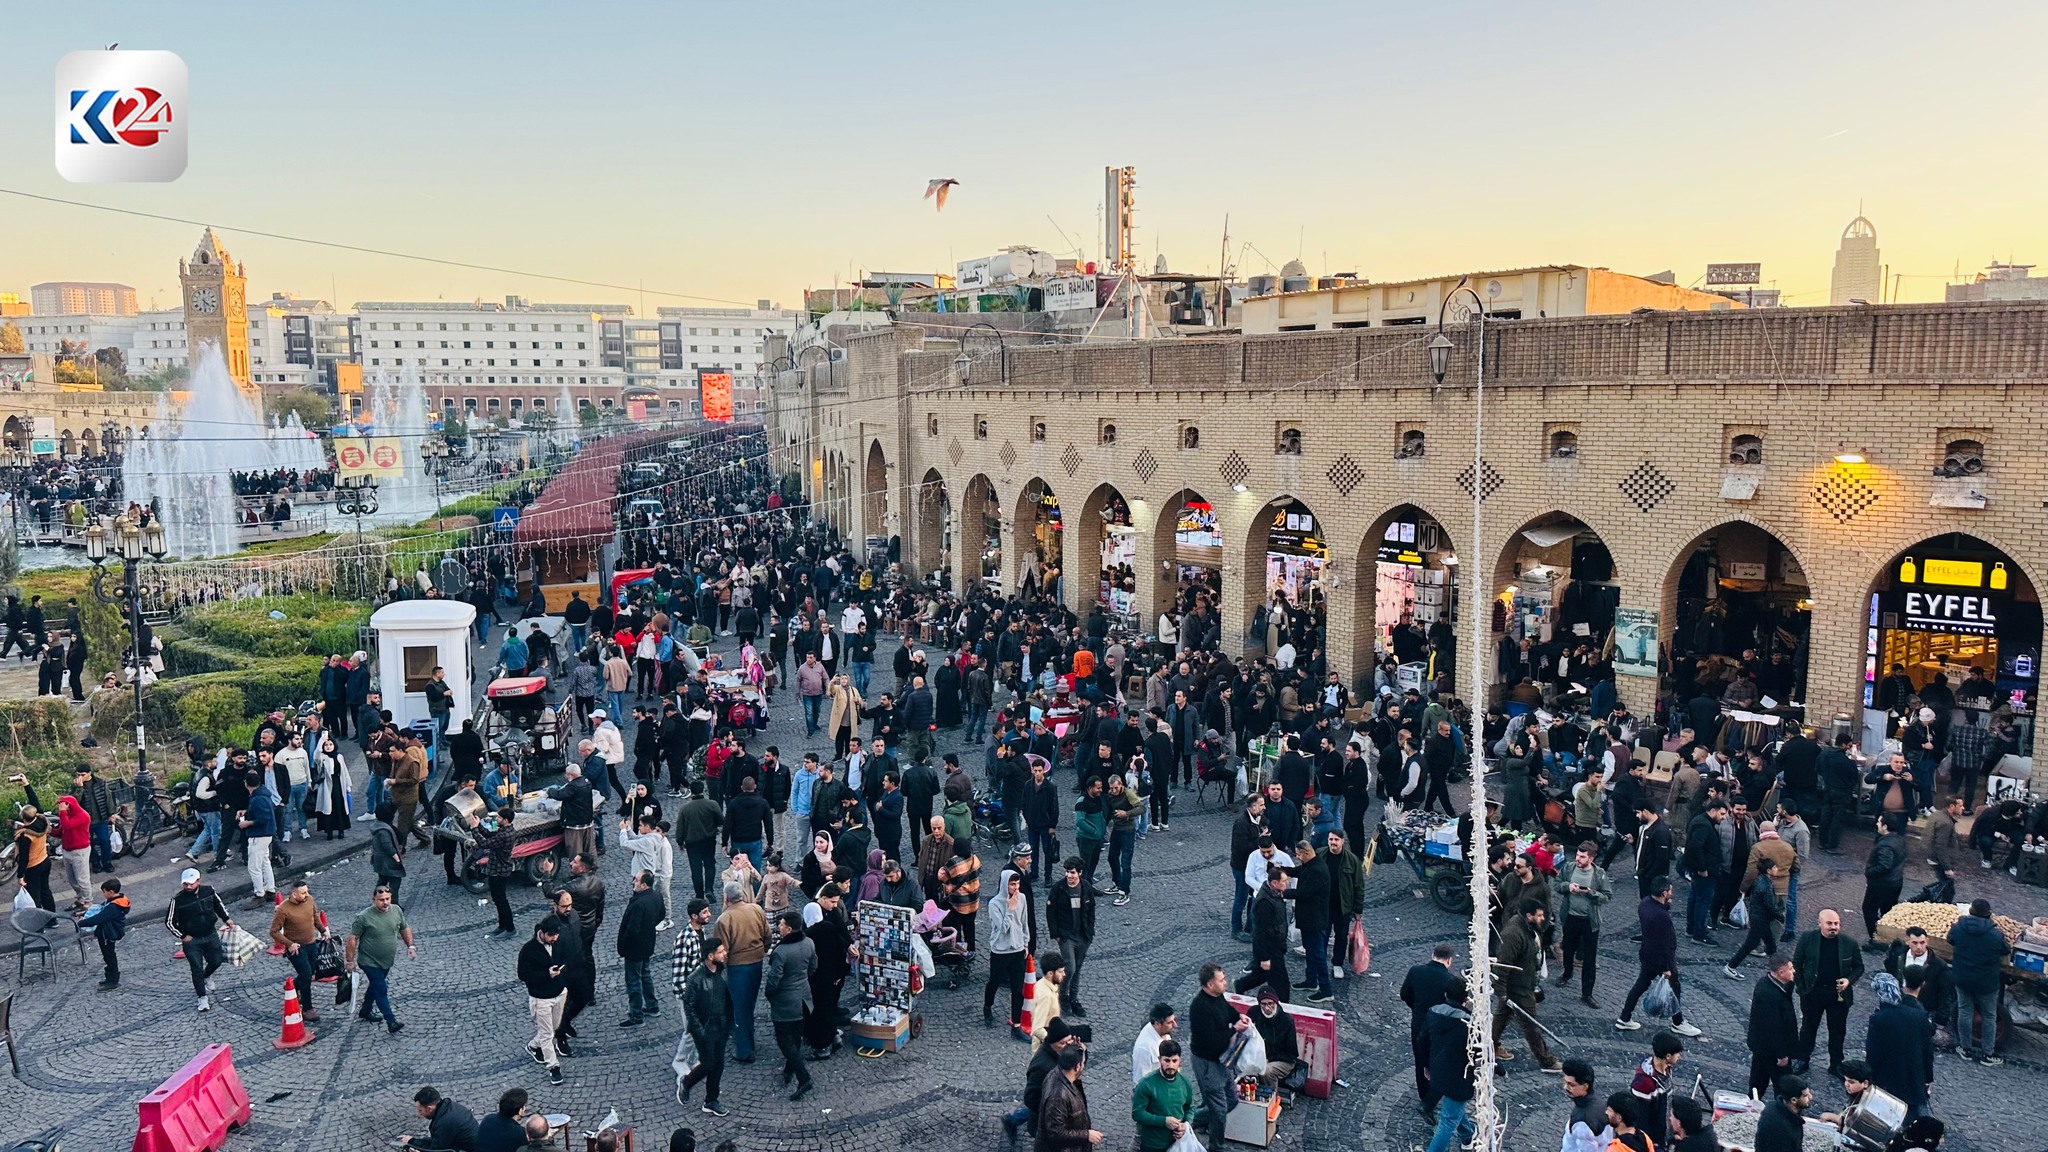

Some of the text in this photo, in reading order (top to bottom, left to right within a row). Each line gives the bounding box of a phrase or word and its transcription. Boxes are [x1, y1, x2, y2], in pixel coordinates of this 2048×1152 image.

[1708, 275, 1734, 283] VANAS
[1045, 278, 1095, 298] HOTEL RAHAND
[1926, 565, 1951, 575] EYFEL
[1905, 592, 1997, 621] EYFEL
[1906, 622, 1926, 630] EAU
[1951, 626, 1995, 635] PARFUM
